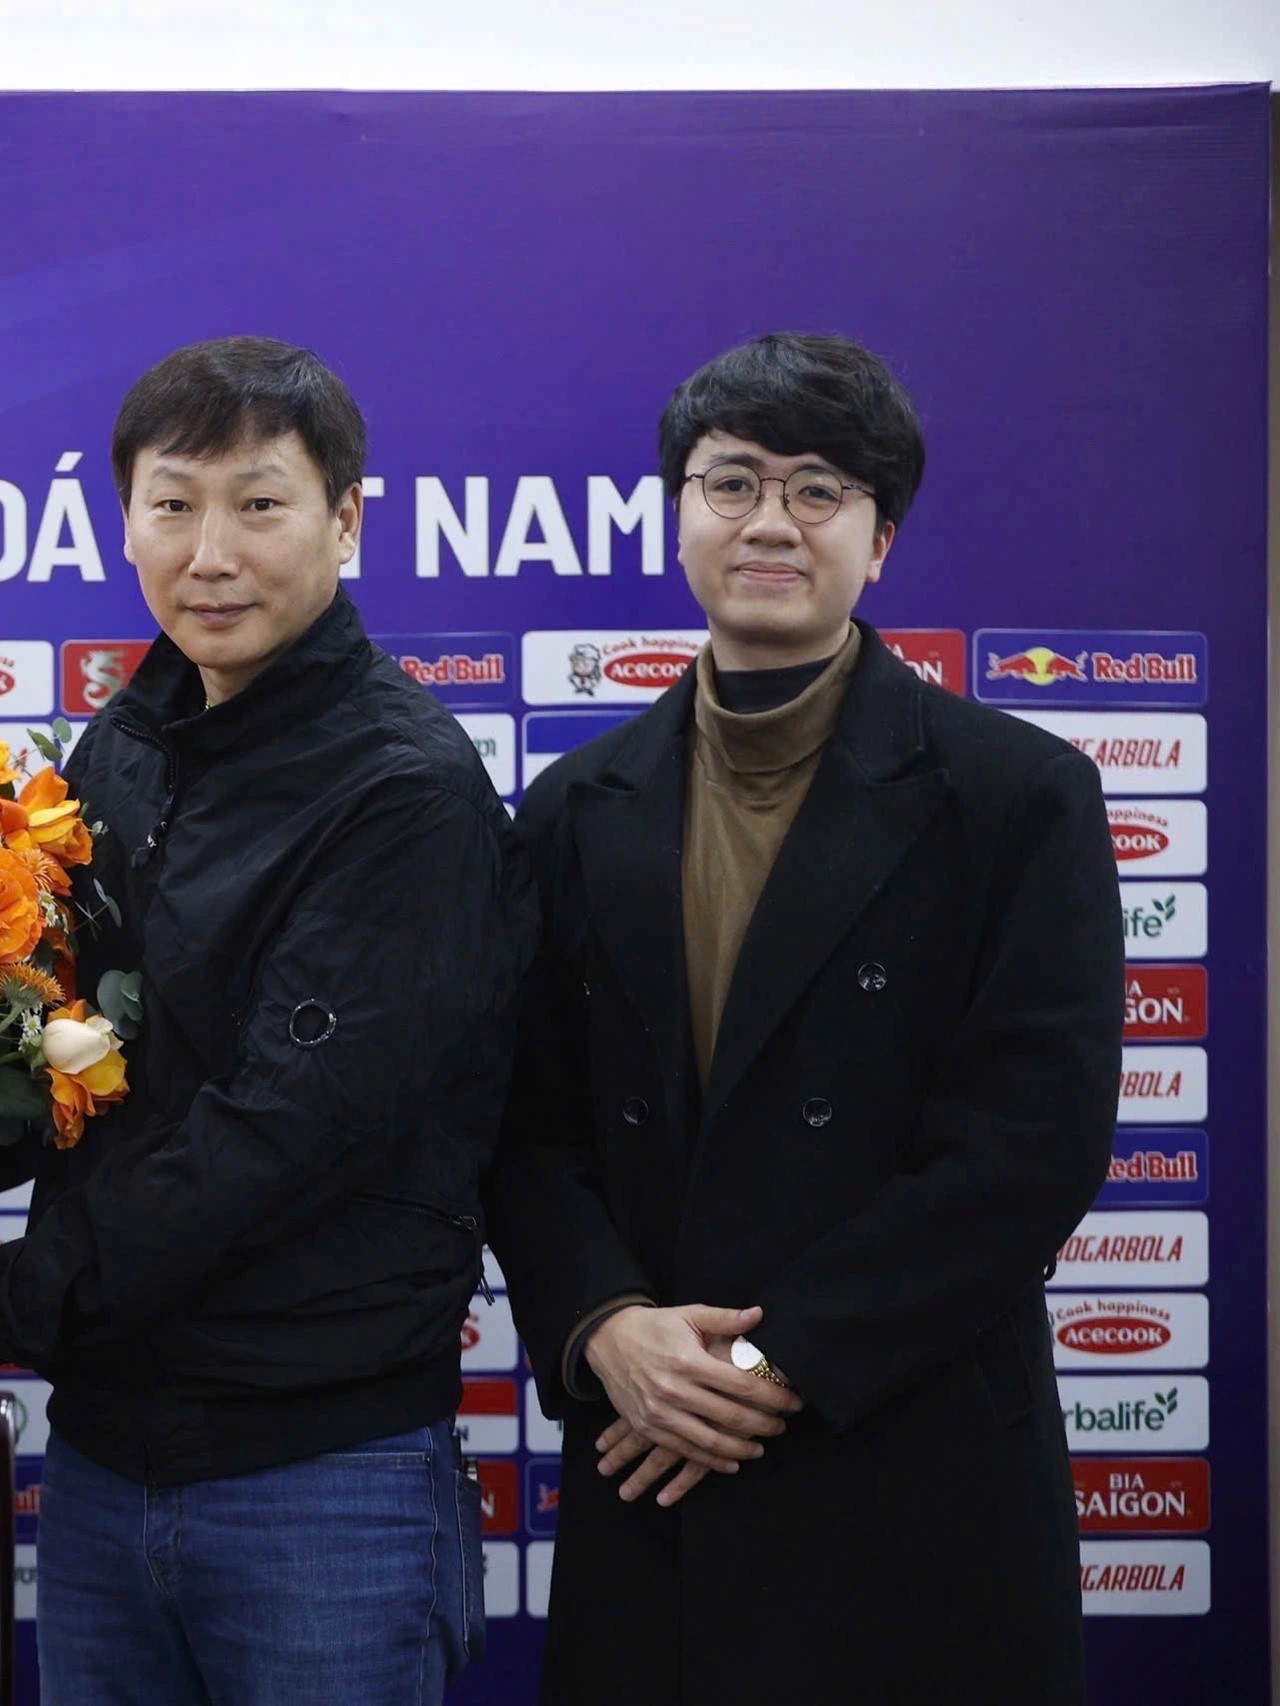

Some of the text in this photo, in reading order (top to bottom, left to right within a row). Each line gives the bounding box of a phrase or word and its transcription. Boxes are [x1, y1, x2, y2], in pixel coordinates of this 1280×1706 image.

[415, 475, 665, 578] NAM
[453, 653, 505, 684] Bull
[1092, 652, 1197, 686] Red Bull
[1107, 807, 1169, 827] appiness
[1124, 997, 1184, 1025] GON
[1146, 1151, 1197, 1183] Bull
[1056, 1299, 1171, 1321] Cook happiness
[1063, 1400, 1165, 1431] rbalife
[1109, 1473, 1144, 1490] BIA
[1080, 1564, 1186, 1592] GARBOLA
